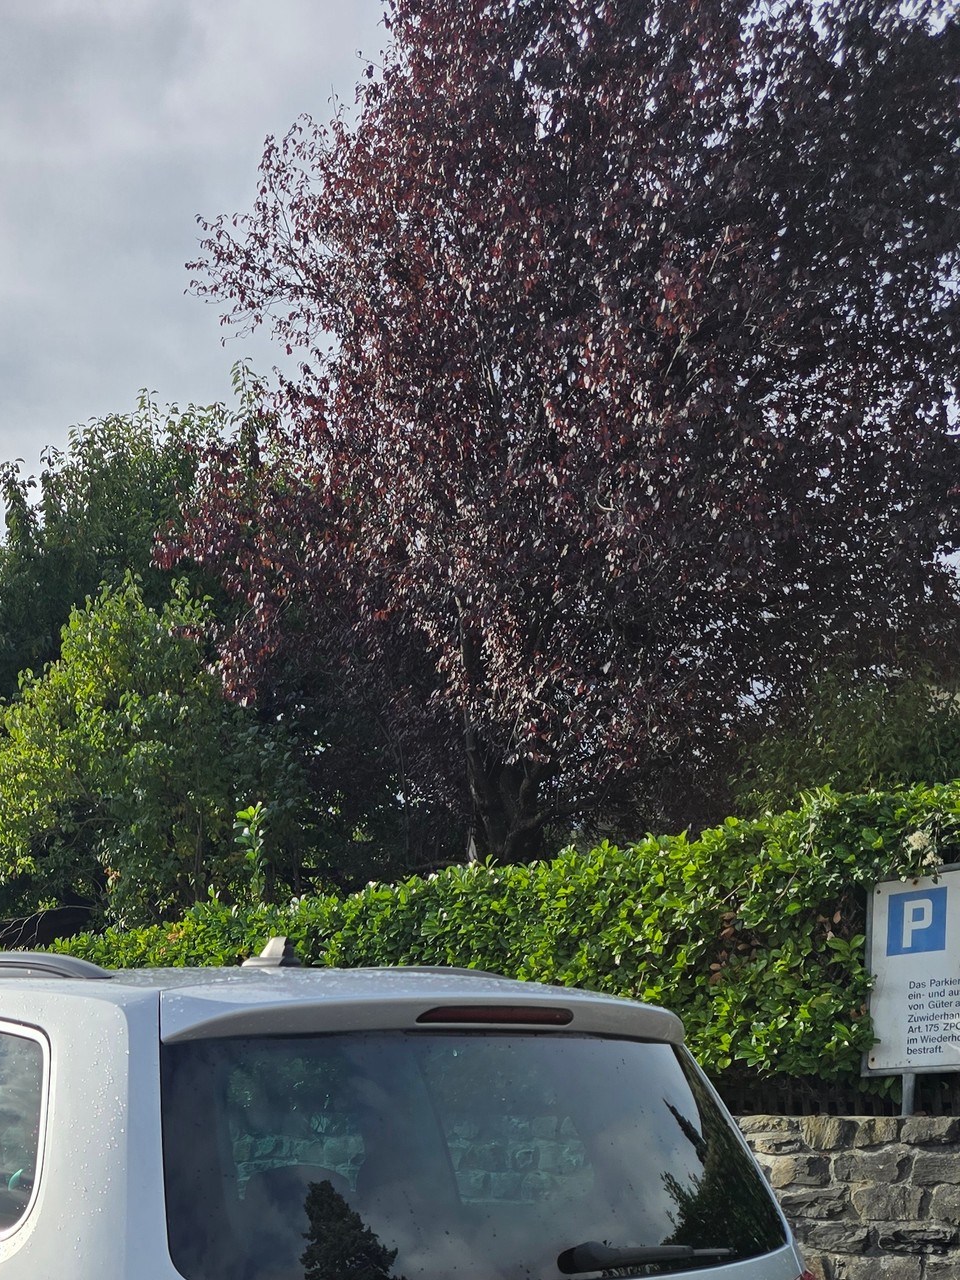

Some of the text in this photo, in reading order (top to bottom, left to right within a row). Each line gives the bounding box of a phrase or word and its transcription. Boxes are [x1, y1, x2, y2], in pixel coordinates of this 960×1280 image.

[902, 898, 933, 948] P
[909, 980, 926, 989] Das
[908, 988, 960, 1000] ein- und au
[908, 1003, 924, 1011] von
[928, 1000, 953, 1010] Güter
[907, 1012, 960, 1023] Zuwiderhan
[907, 1025, 923, 1034] Art.
[925, 1023, 940, 1032] 175
[906, 1036, 918, 1045] im
[906, 1045, 944, 1055] bestraft.
